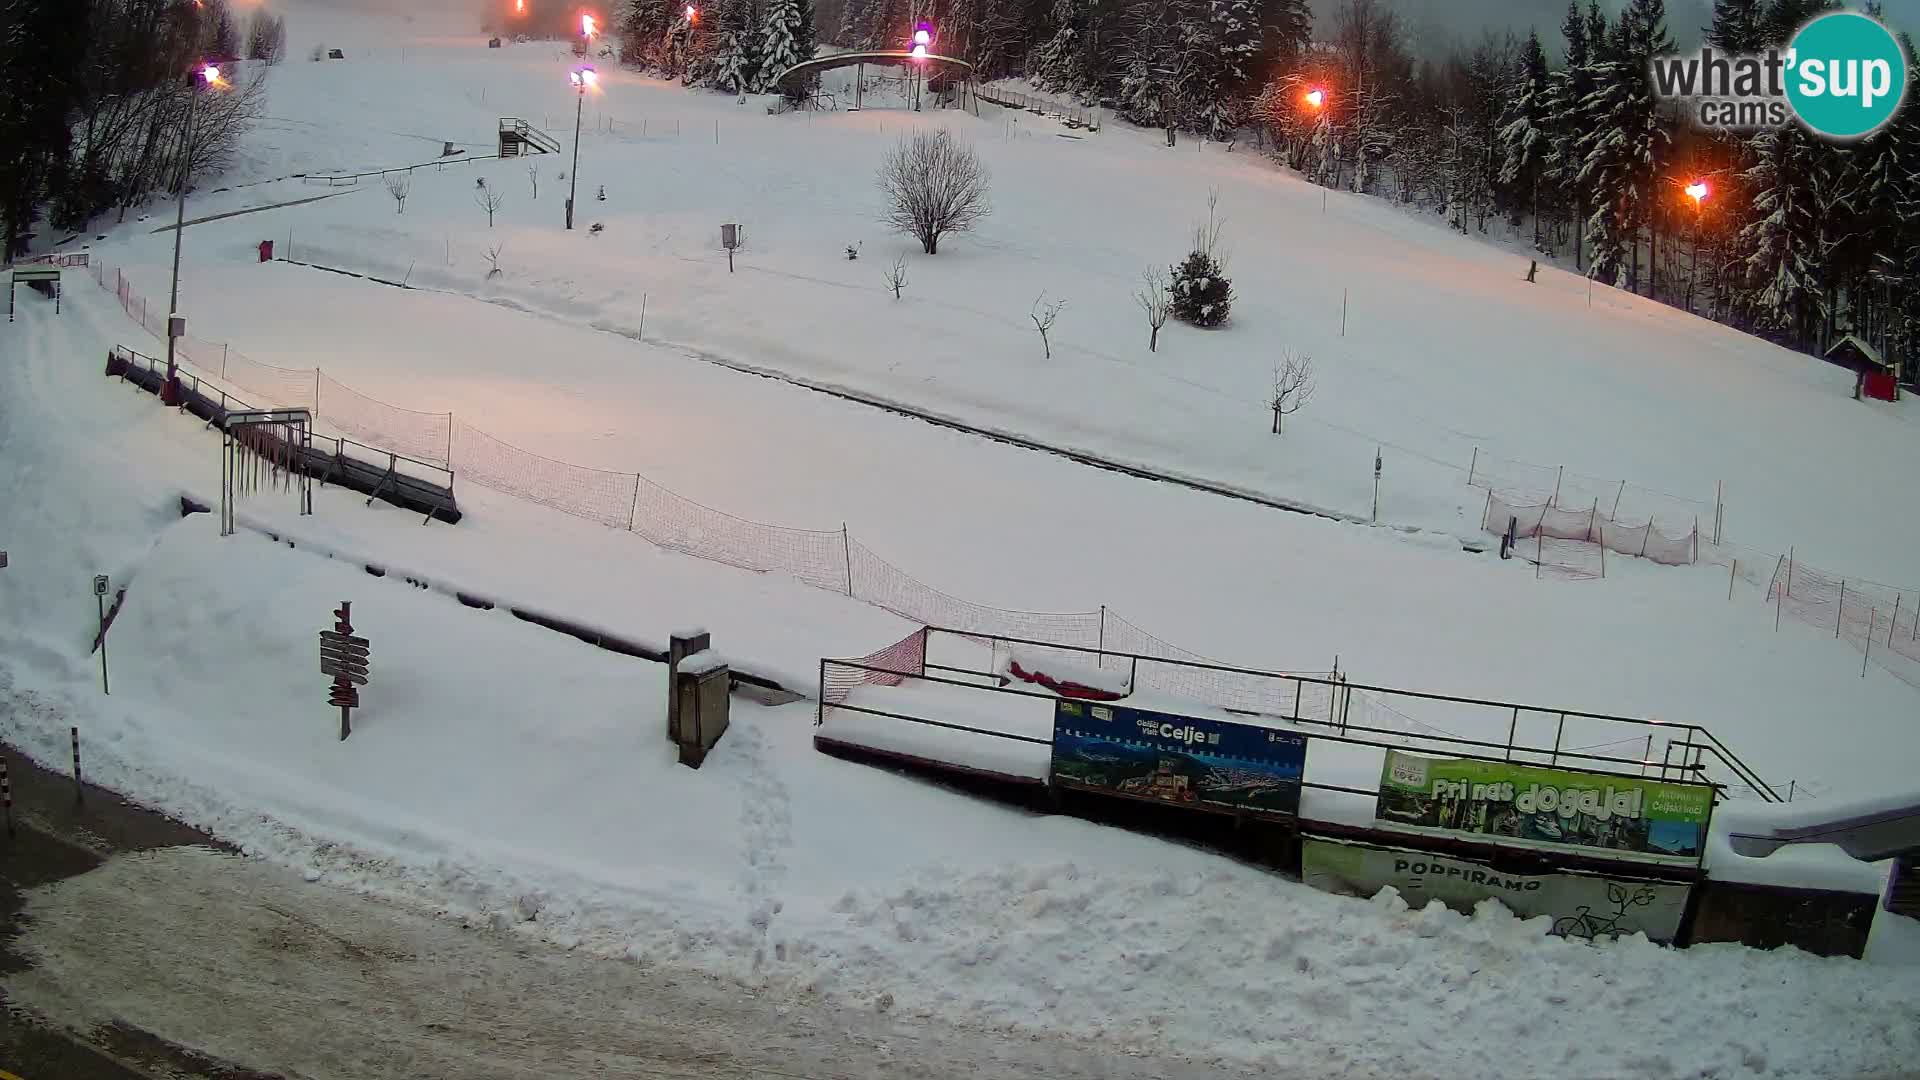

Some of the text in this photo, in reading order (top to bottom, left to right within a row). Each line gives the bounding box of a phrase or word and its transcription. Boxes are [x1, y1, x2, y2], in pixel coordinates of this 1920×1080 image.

[1159, 723, 1205, 745] Celje
[1431, 778, 1643, 822] Pri nas dogaja!
[1394, 859, 1542, 892] PODPIRAMO
